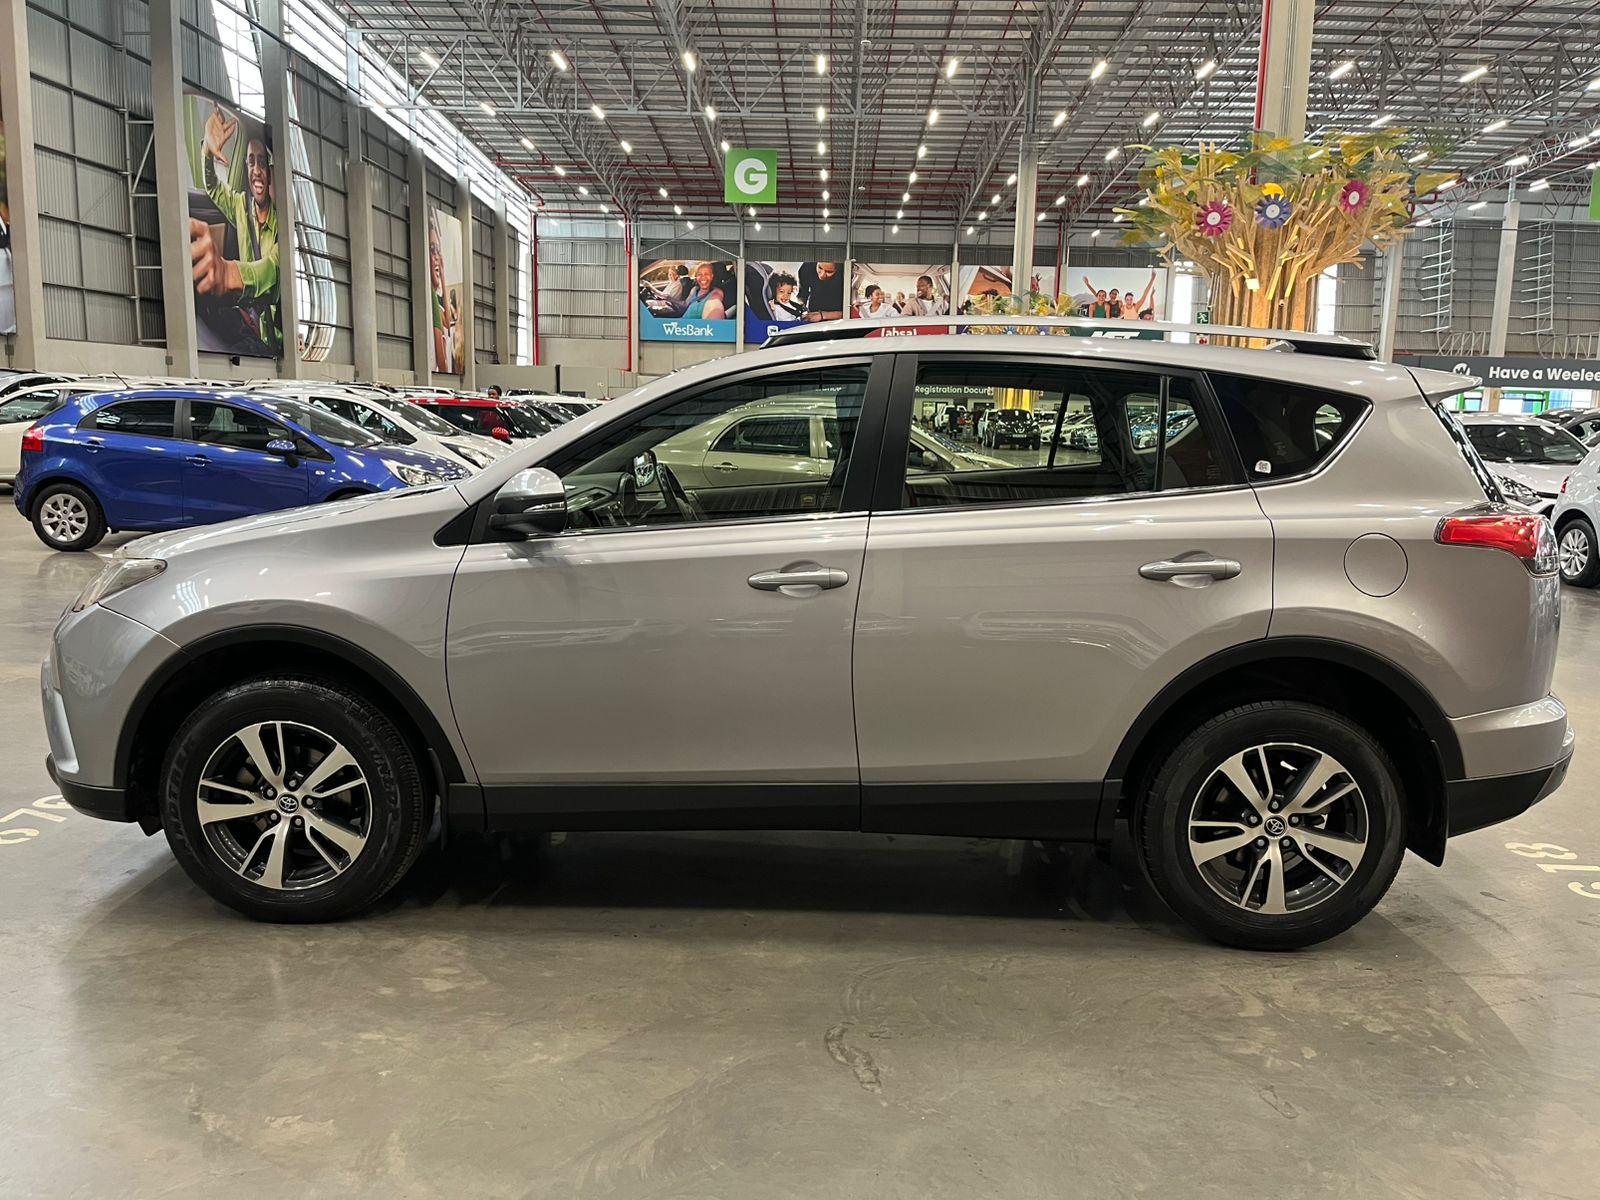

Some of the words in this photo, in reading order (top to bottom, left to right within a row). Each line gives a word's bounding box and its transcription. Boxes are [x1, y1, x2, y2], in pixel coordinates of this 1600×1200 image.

[734, 158, 768, 195] G
[662, 321, 714, 337] WesBank
[1488, 366, 1530, 380] Have
[1532, 371, 1543, 380] a
[915, 385, 962, 394] Registration
